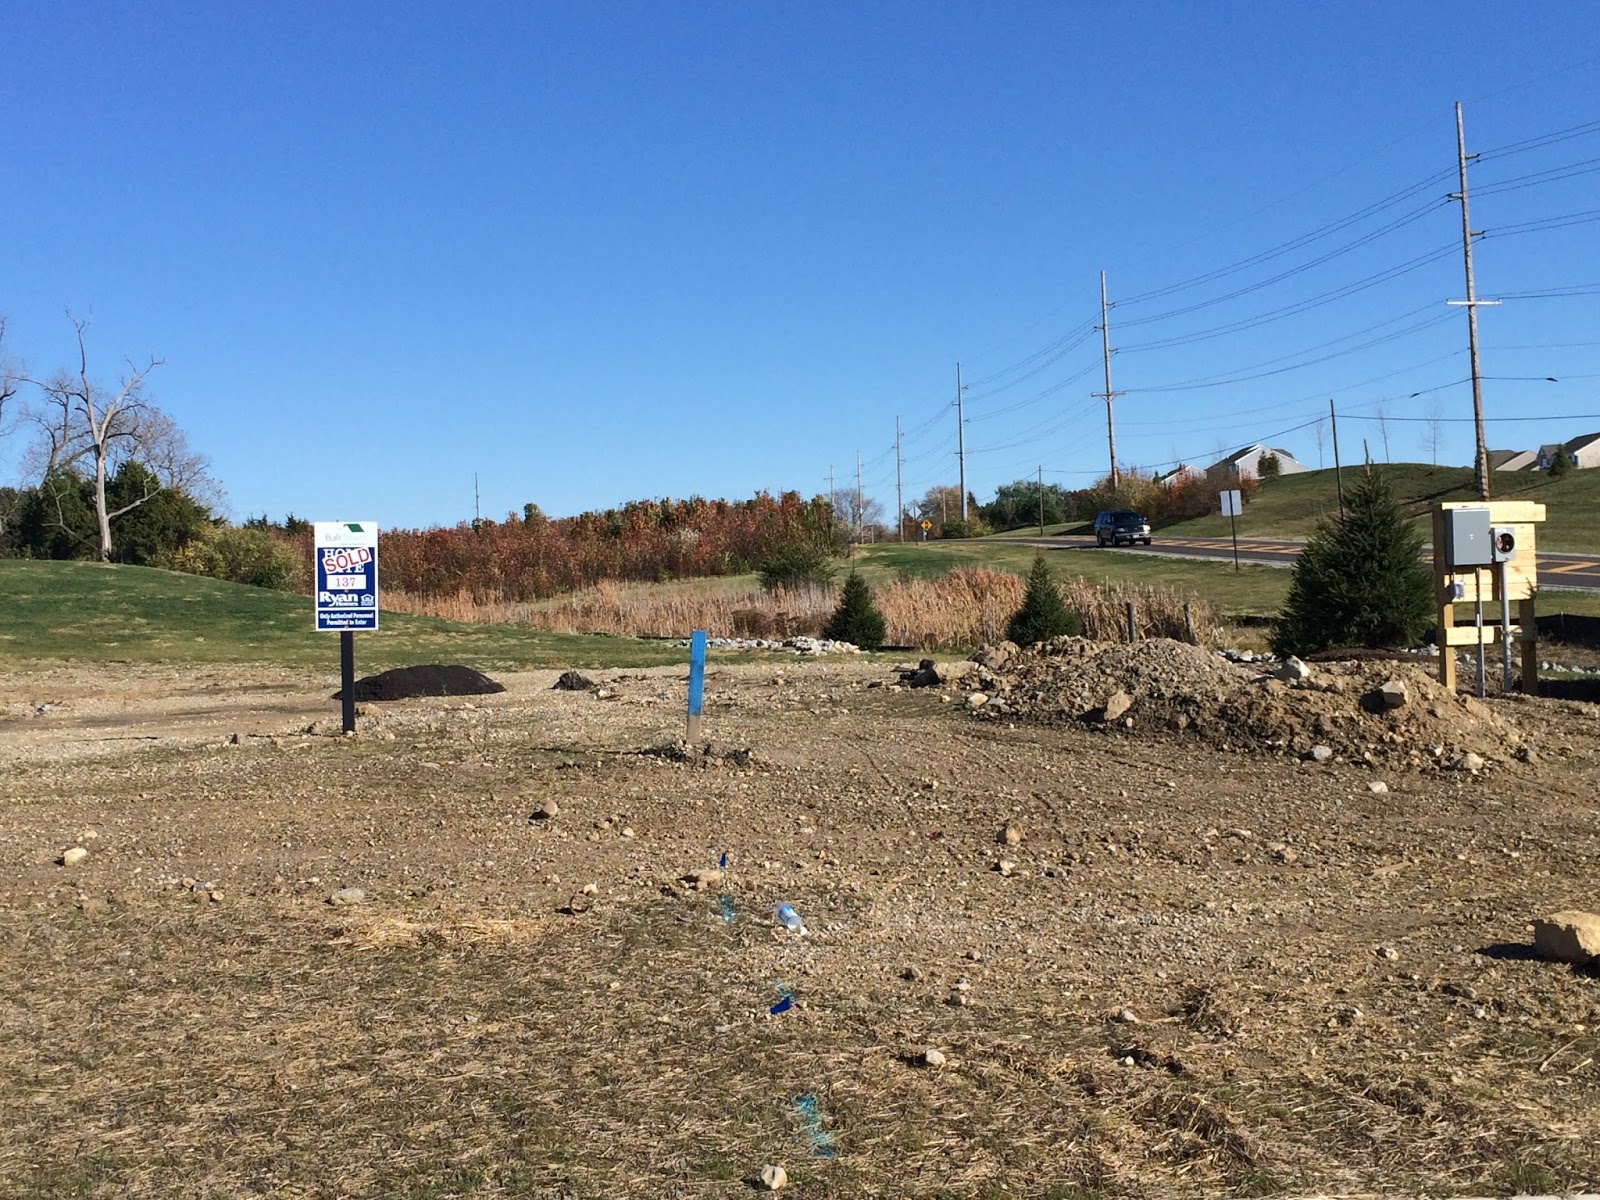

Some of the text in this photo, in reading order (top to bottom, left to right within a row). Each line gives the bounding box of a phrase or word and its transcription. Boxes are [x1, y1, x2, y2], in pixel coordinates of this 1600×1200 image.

[325, 548, 370, 572] SOLD
[336, 577, 356, 587] 137
[319, 591, 359, 607] Ryan
